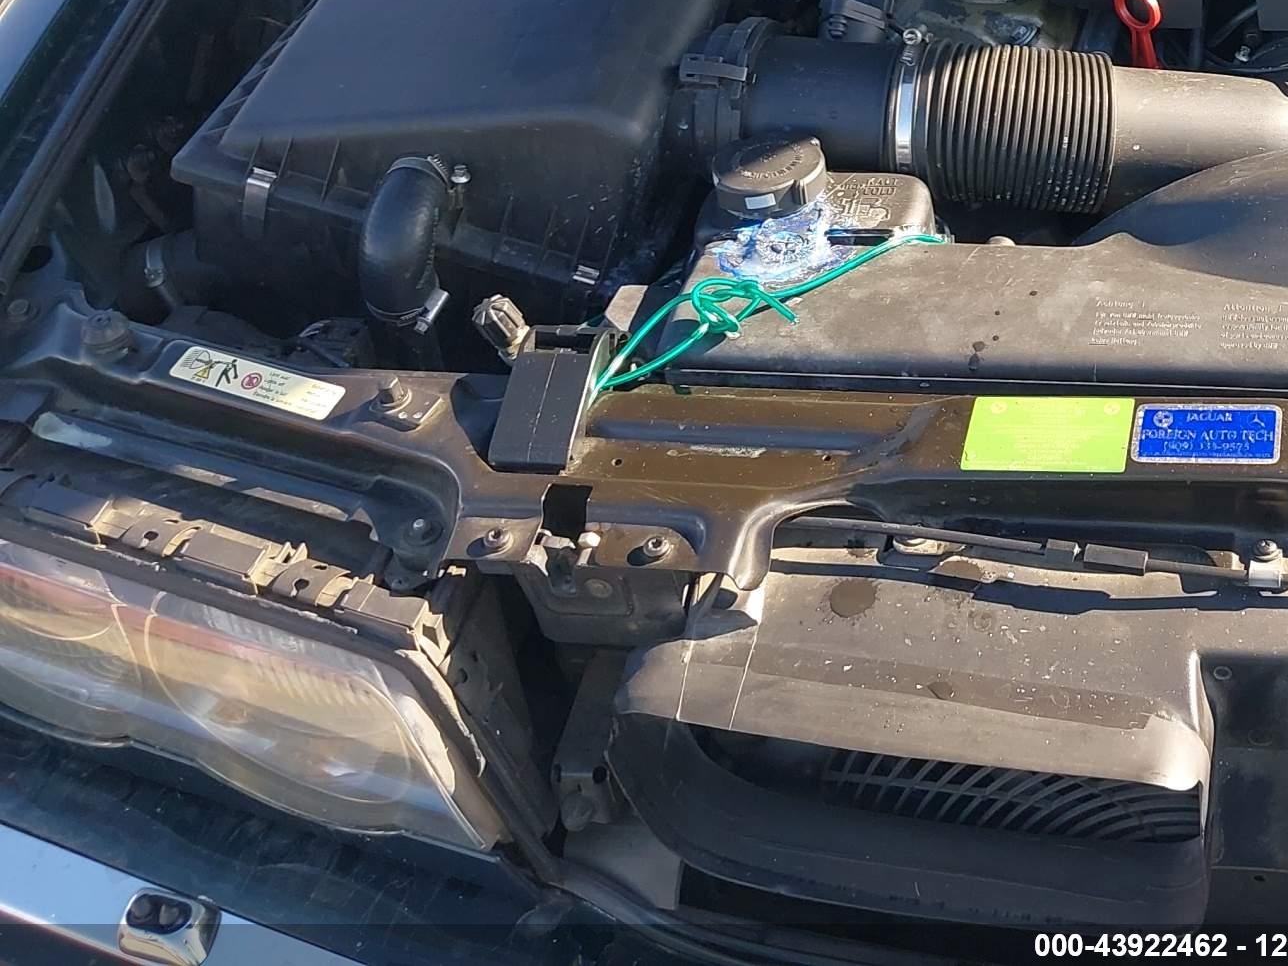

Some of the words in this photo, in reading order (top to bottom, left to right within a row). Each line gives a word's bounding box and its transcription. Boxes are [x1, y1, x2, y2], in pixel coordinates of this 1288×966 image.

[1186, 412, 1233, 422] JAGUAR
[1141, 429, 1197, 441] FOREIGN
[1200, 429, 1238, 441] AUTO
[1242, 429, 1274, 443] TECH
